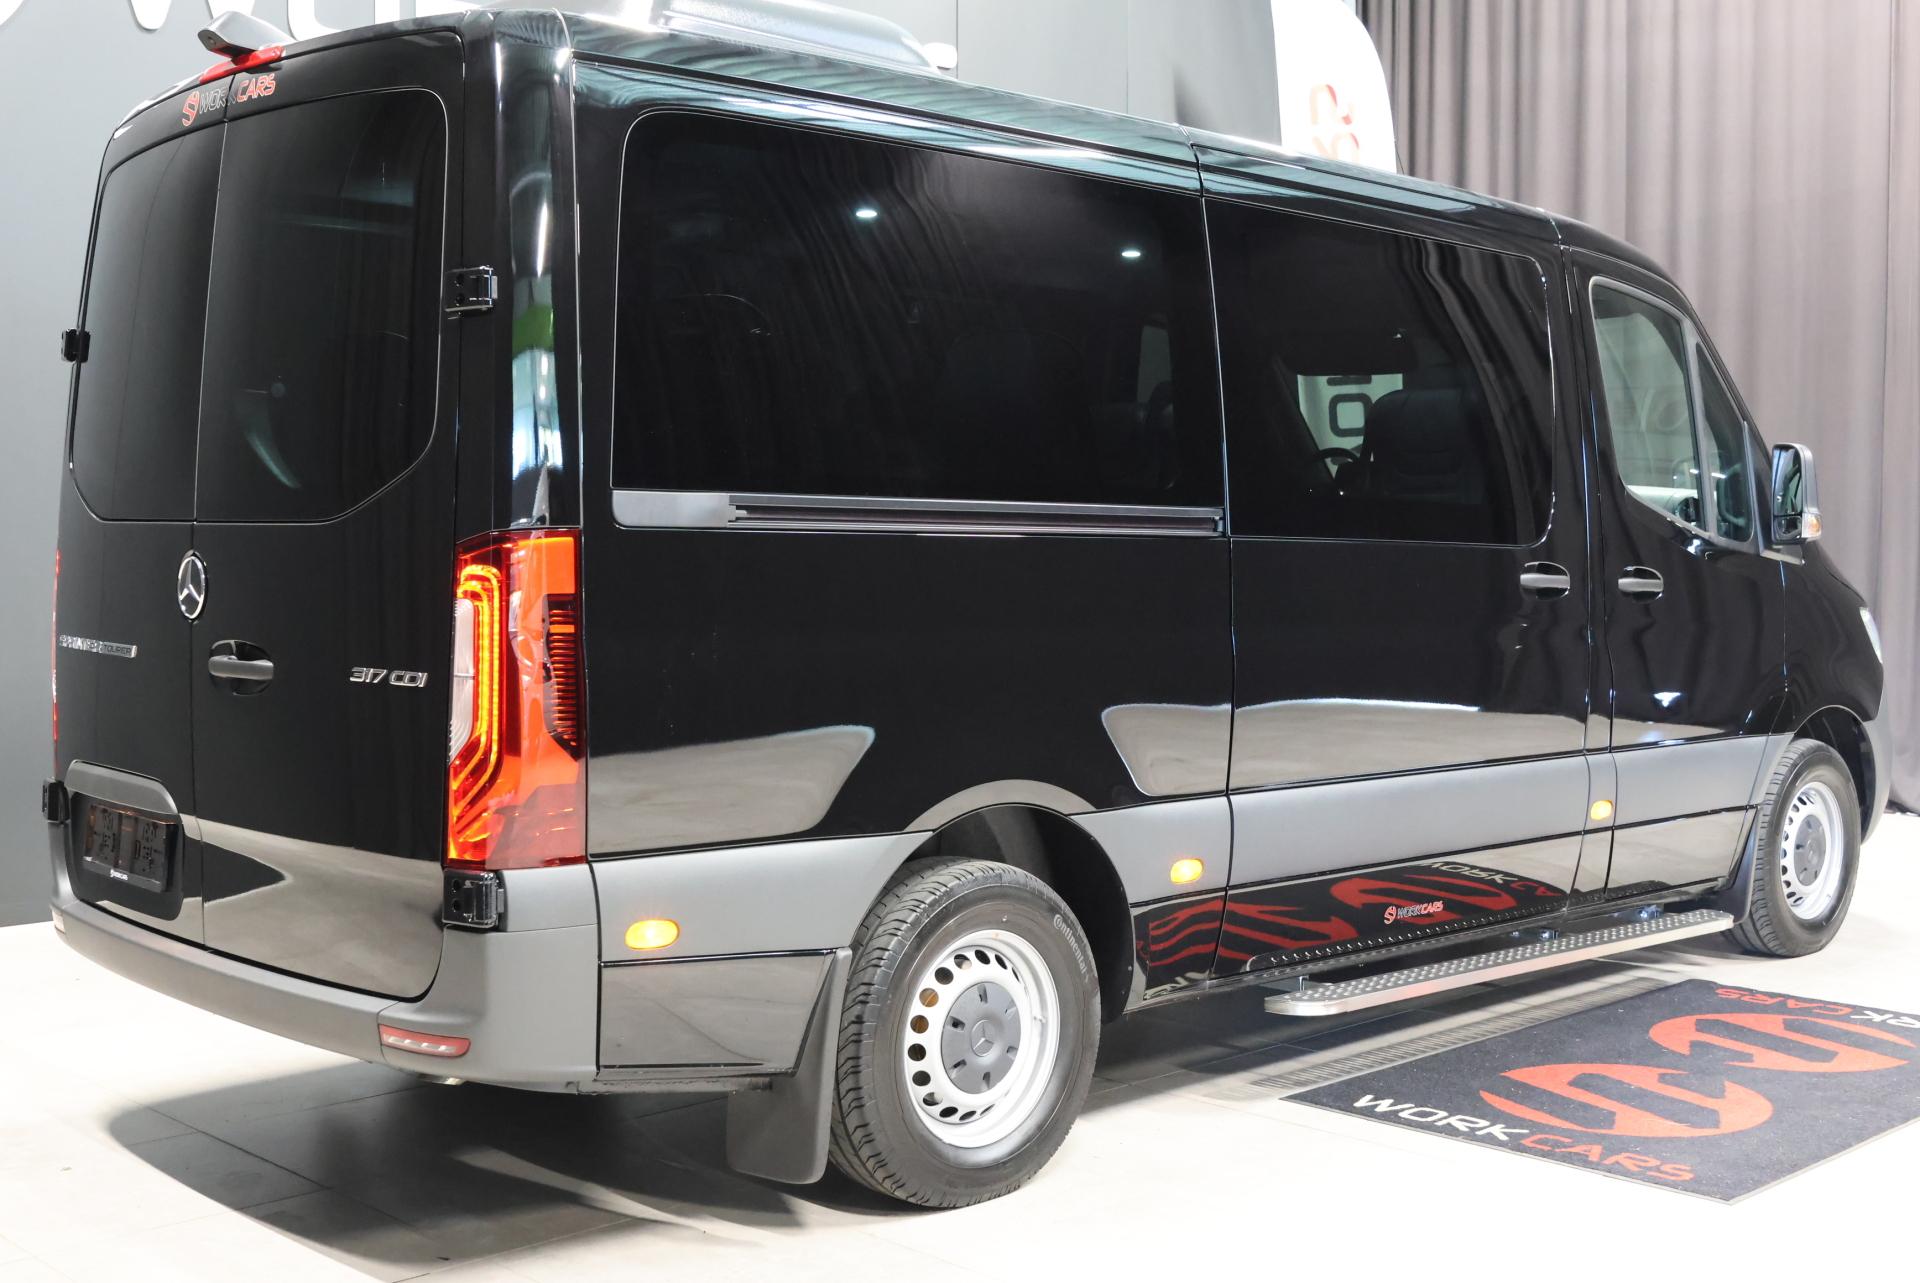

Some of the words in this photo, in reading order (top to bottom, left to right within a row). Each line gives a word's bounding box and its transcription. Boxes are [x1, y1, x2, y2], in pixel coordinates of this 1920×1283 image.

[198, 72, 277, 115] WORKCARS
[349, 666, 388, 684] 317
[389, 670, 428, 688] CDI
[1396, 900, 1445, 919] WORKCARS
[1053, 913, 1088, 975] Continental
[1714, 987, 1920, 1030] RKCARS
[1352, 1093, 1696, 1183] WORKCARS
